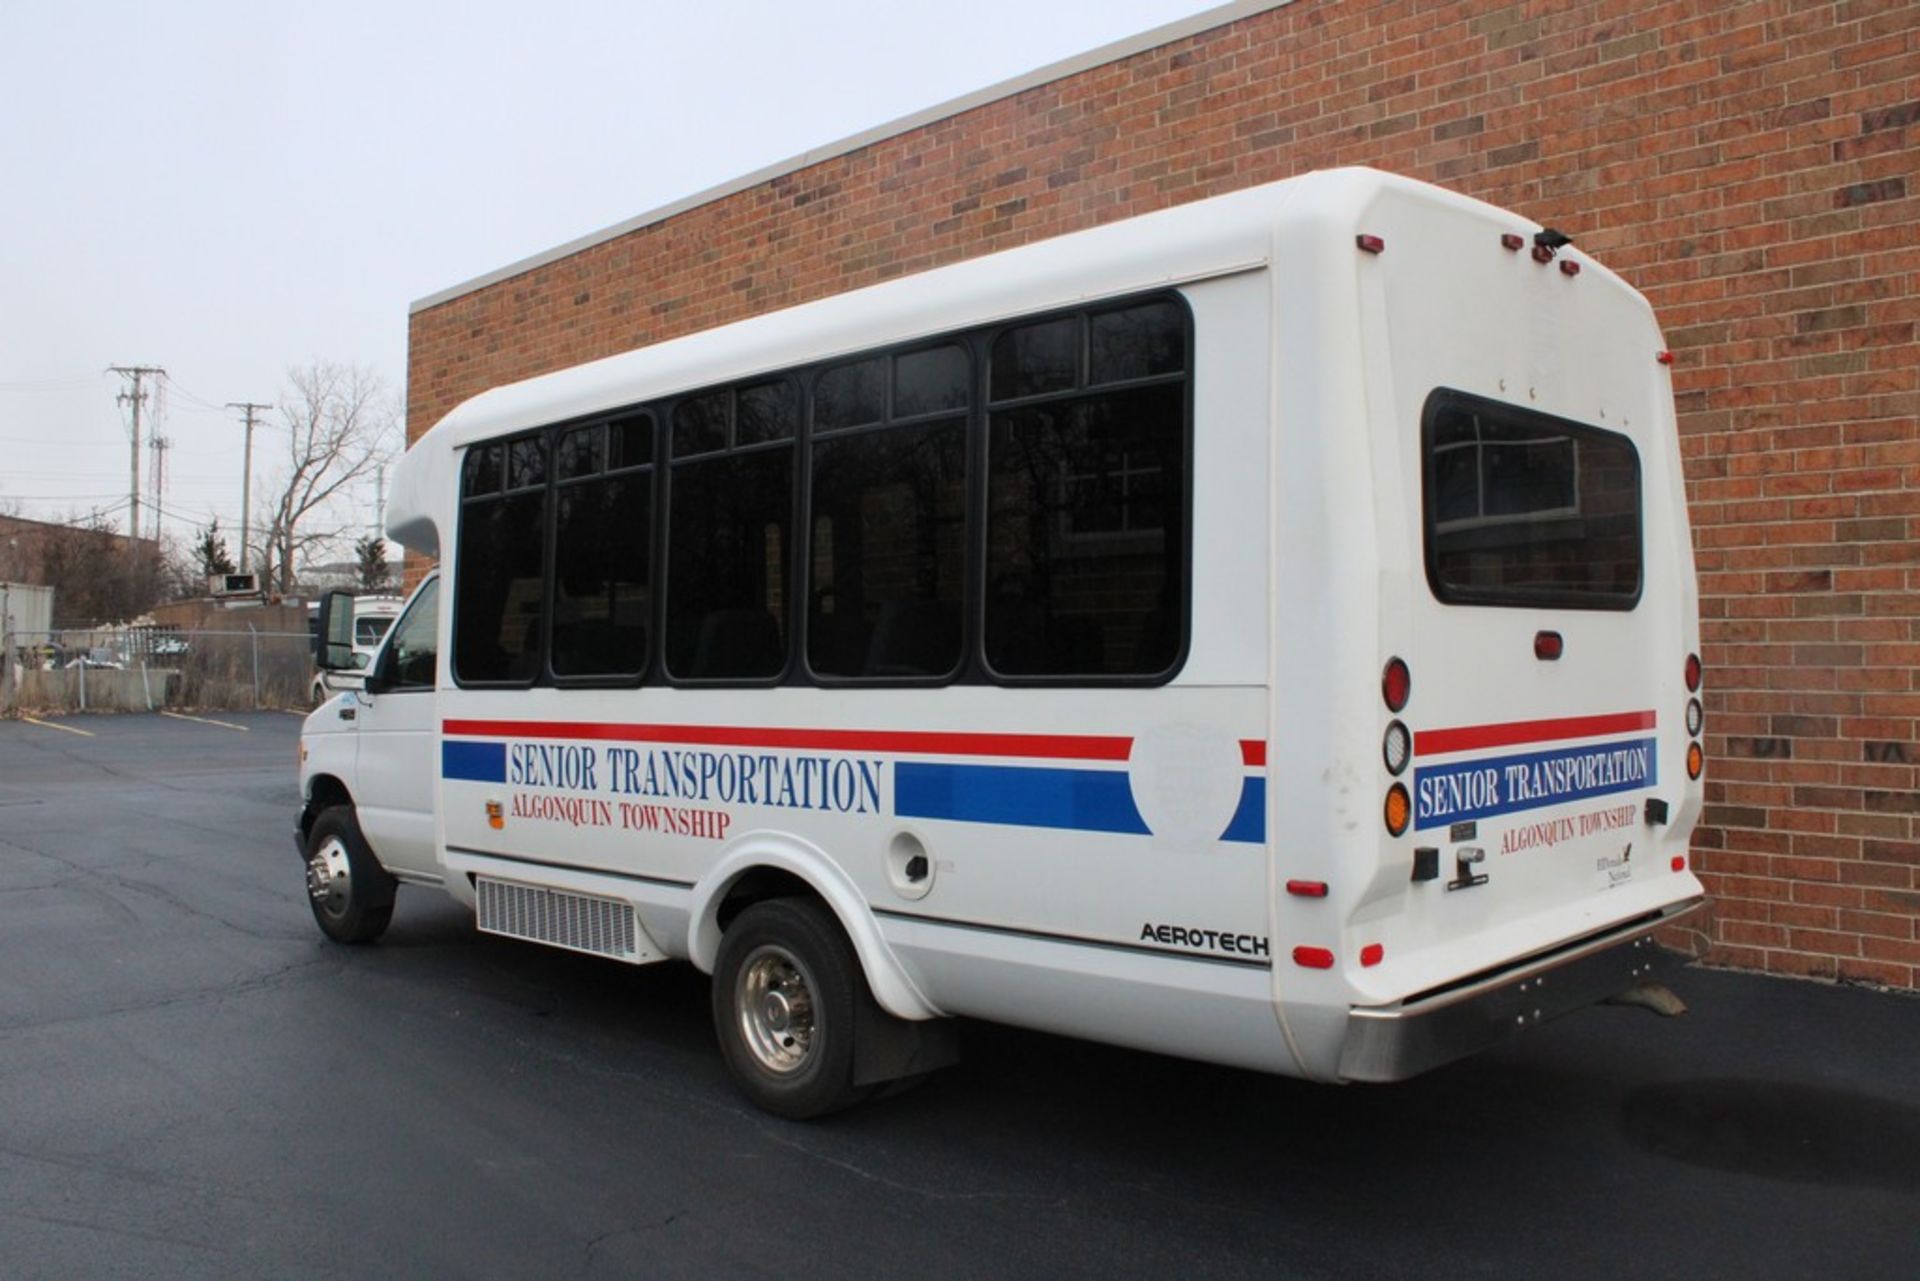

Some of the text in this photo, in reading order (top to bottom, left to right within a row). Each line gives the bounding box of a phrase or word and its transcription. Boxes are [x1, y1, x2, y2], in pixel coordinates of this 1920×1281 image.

[511, 743, 882, 813] SENIOR TRANSPORTATION
[1419, 748, 1647, 817] SENIOR TRANSPORTATION
[511, 795, 730, 840] ALGONQUIN TOWNSHIP
[1501, 818, 1575, 855] ALGONQUIN
[1579, 805, 1636, 836] TOWNSHIP
[1140, 923, 1269, 956] AEROTECH
